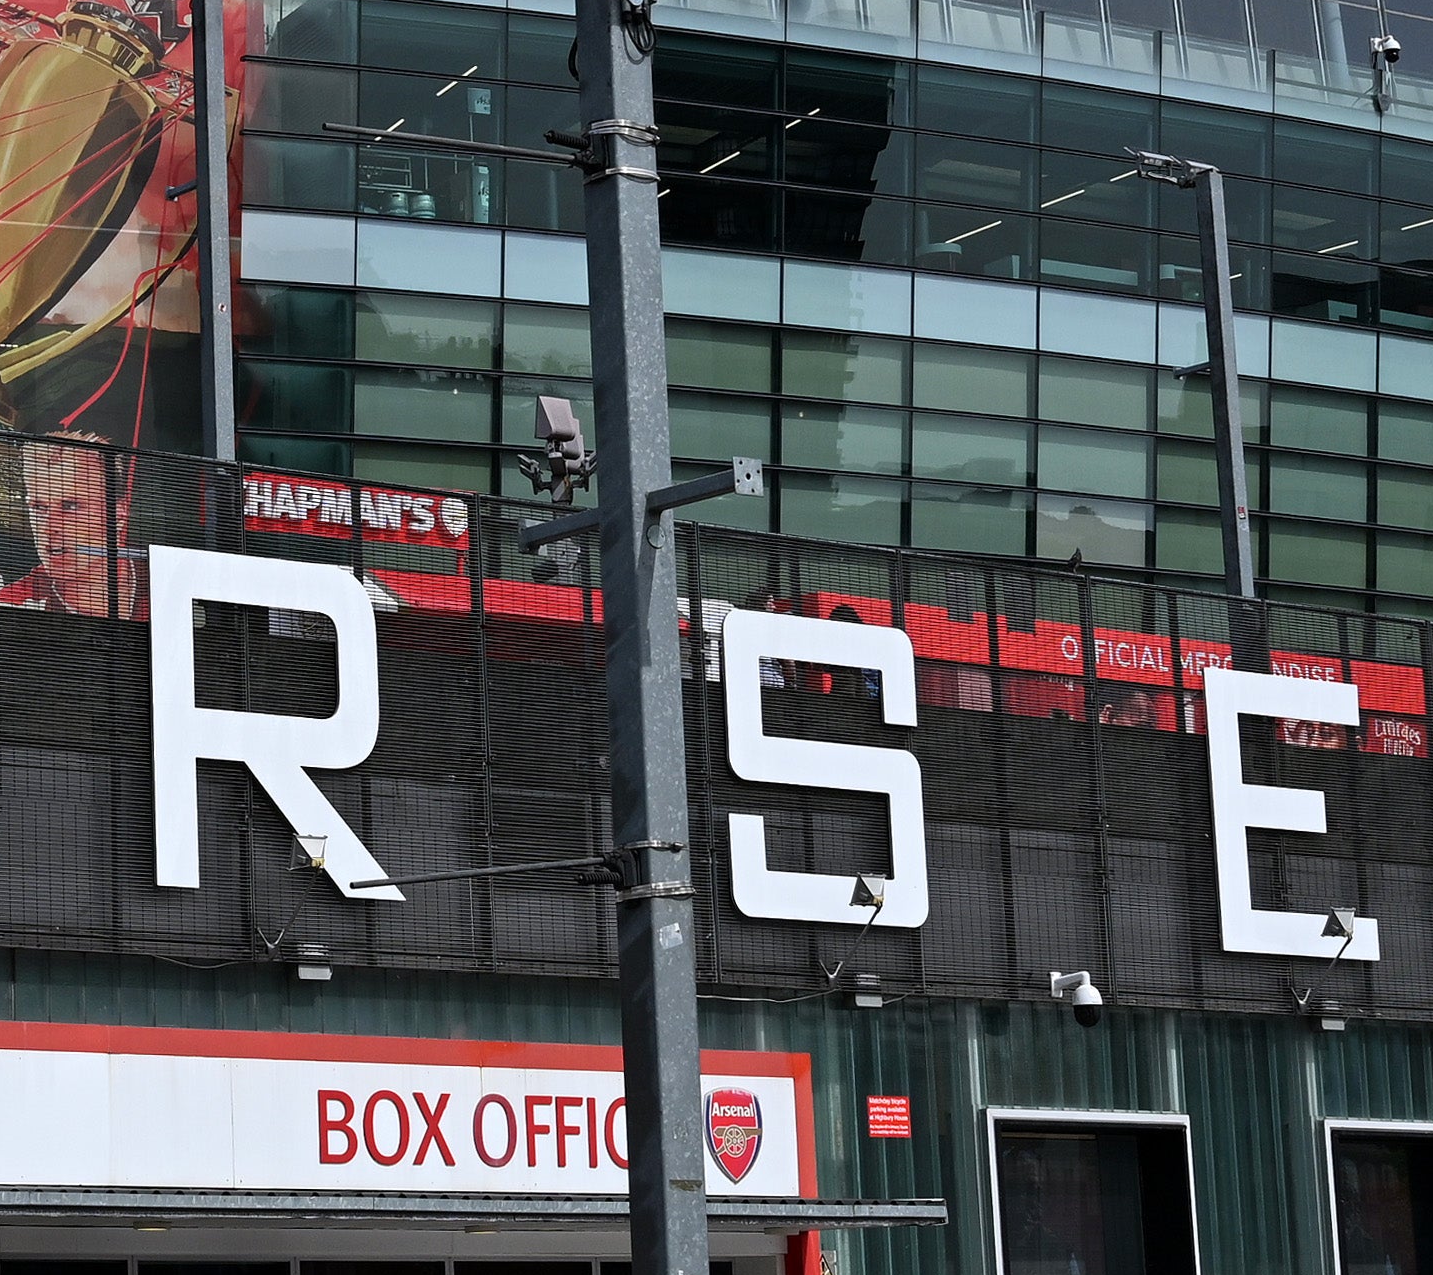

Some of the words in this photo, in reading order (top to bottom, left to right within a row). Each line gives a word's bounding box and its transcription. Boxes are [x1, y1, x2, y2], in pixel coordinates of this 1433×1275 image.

[243, 478, 435, 532] HAPMAN'S
[1061, 635, 1170, 673] OFICIAL
[317, 1089, 456, 1167] BOX
[472, 1093, 630, 1170] OFFIC
[712, 1102, 754, 1117] Arsenal
